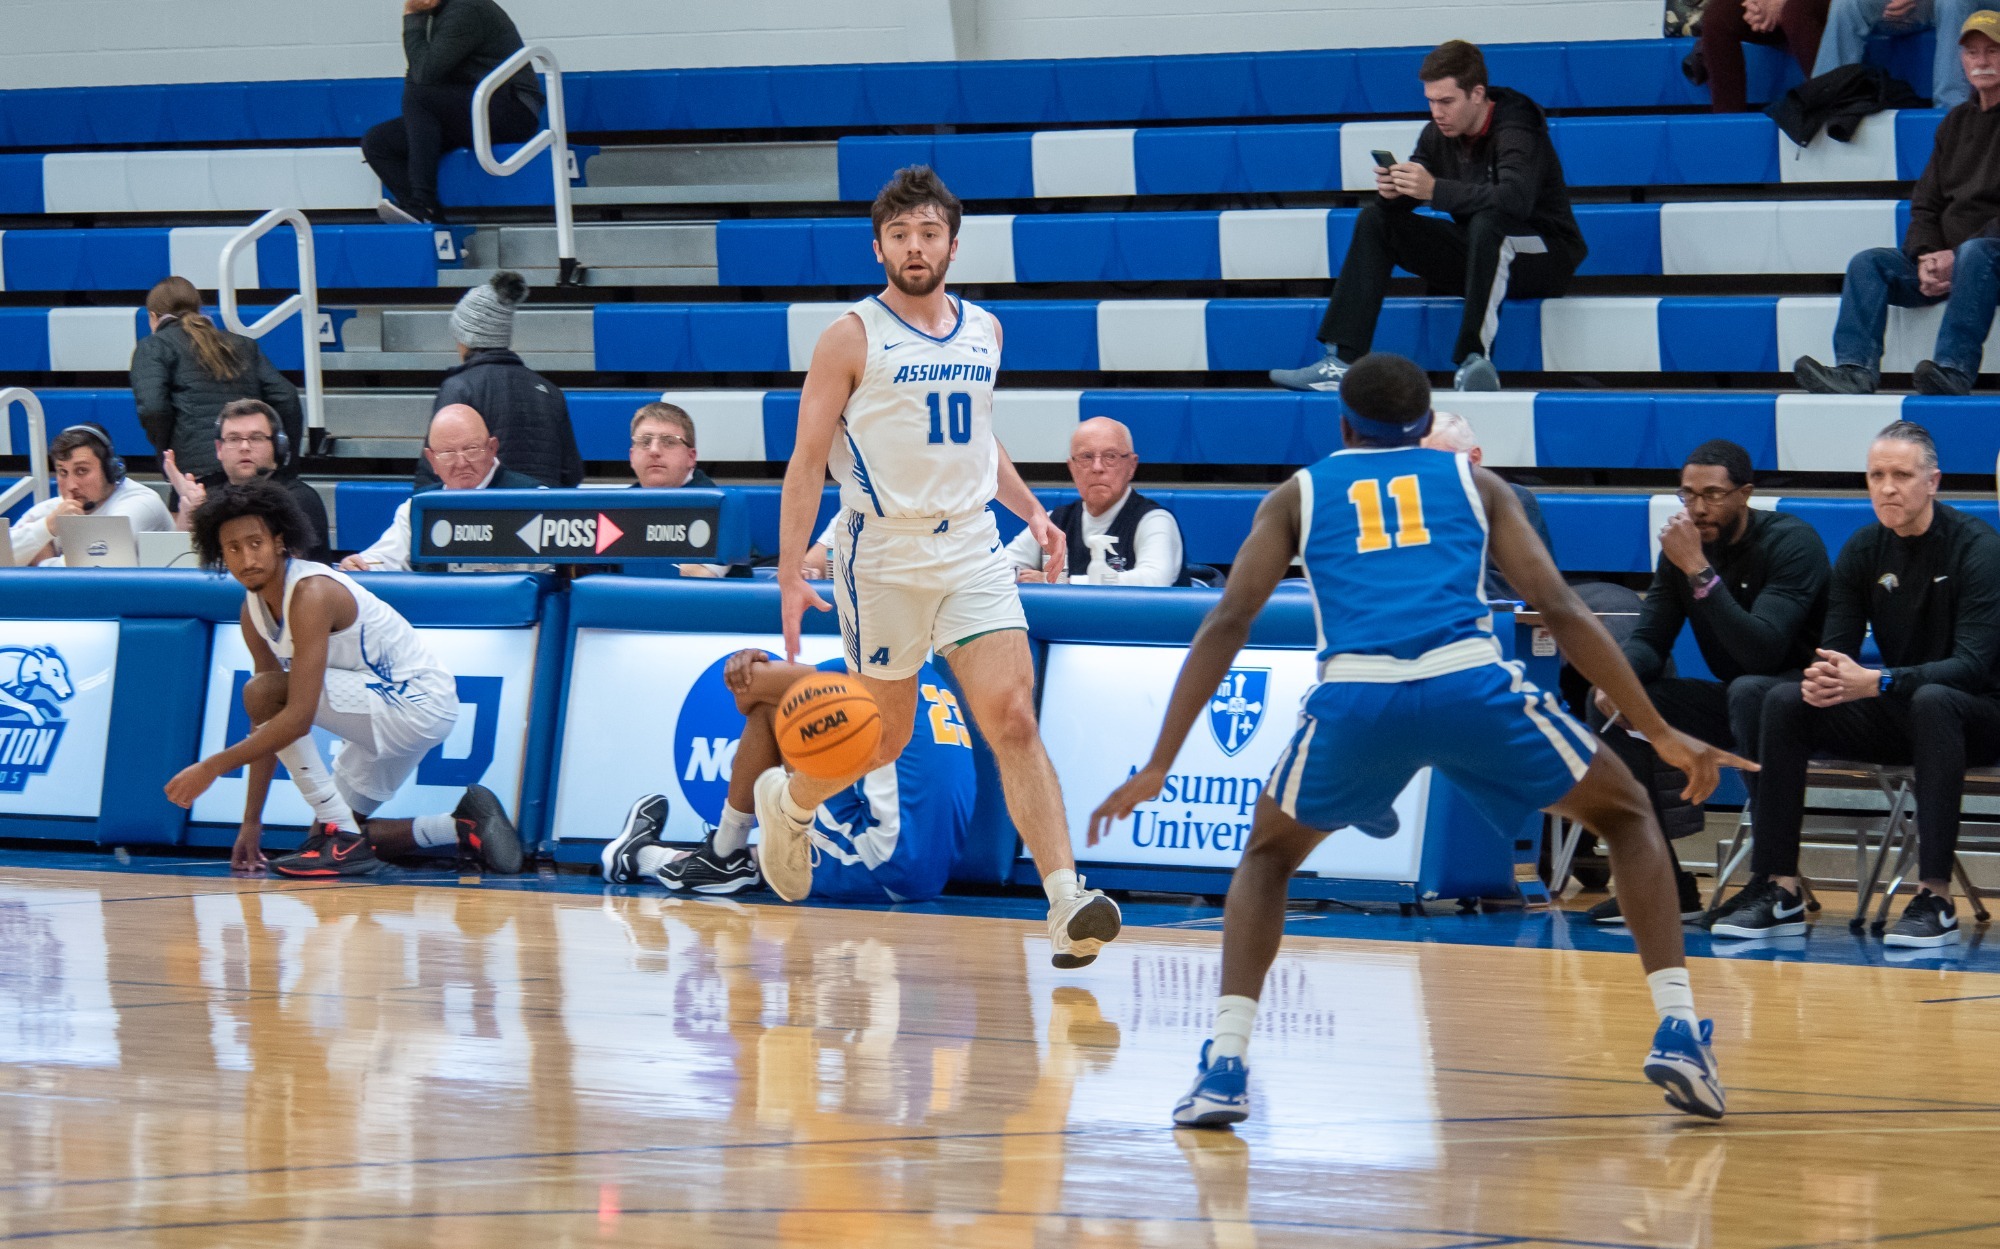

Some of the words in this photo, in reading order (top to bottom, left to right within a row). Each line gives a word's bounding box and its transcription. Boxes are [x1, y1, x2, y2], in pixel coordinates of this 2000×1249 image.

[893, 364, 992, 384] ASSUMPTION
[925, 391, 973, 445] 10
[933, 519, 949, 534] A
[1347, 474, 1431, 553] 11
[454, 524, 494, 542] BONUS
[541, 518, 597, 547] POSS
[646, 524, 686, 542] BONUS
[868, 646, 891, 666] A
[800, 709, 848, 743] NCAA
